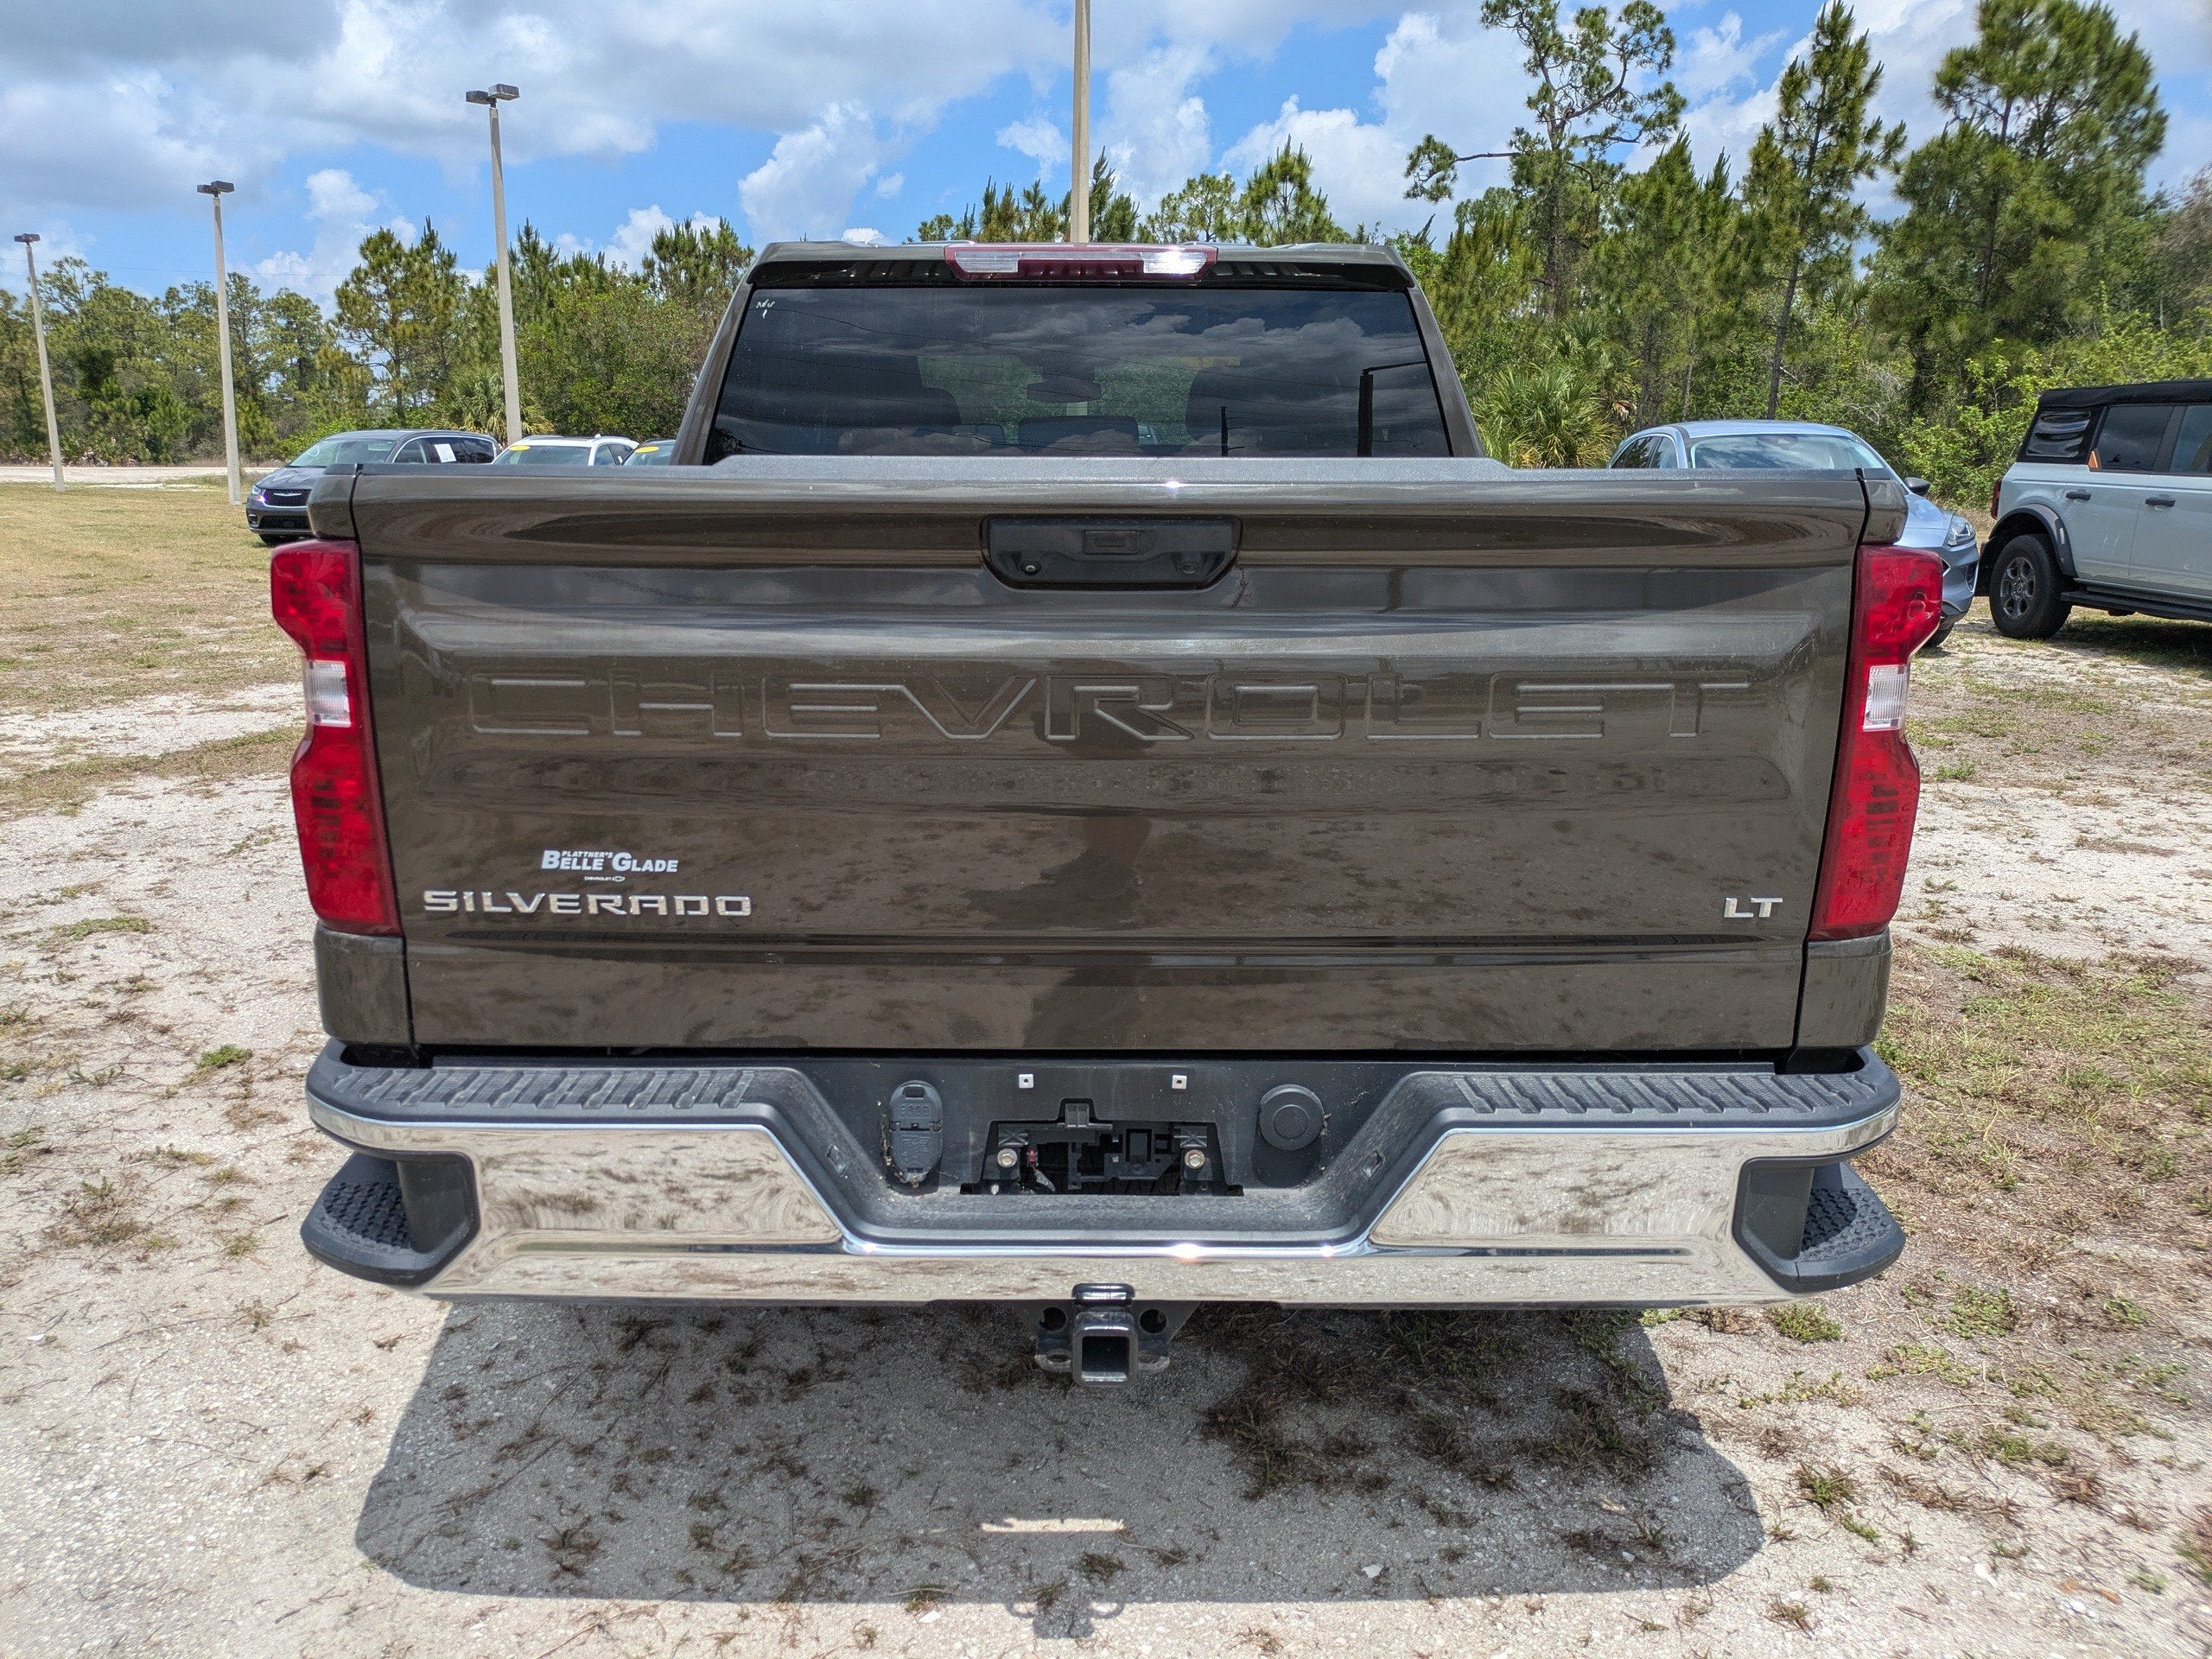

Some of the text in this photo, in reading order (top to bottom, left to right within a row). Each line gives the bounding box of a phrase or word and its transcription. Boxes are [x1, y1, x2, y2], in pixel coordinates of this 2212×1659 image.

[468, 671, 1752, 740] CHEVROLET
[541, 850, 678, 873] BELLE GLADE
[423, 891, 752, 917] SILVERADO
[1723, 897, 1783, 918] LT
